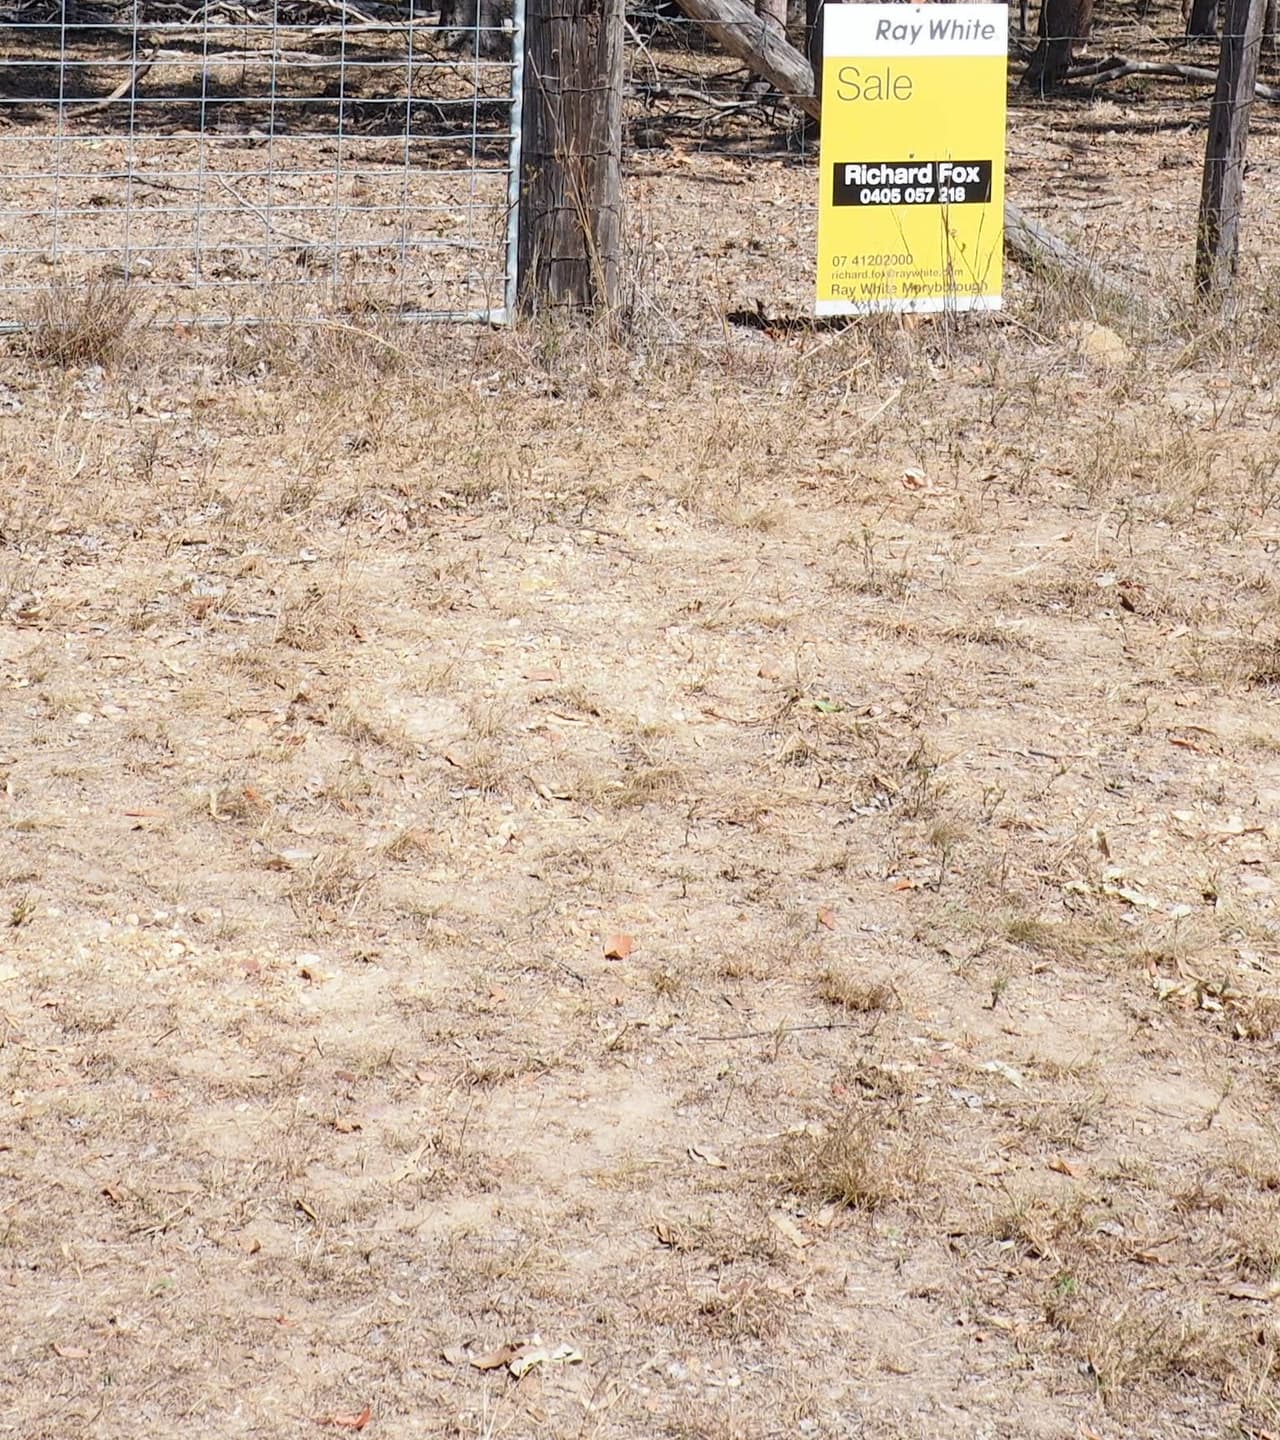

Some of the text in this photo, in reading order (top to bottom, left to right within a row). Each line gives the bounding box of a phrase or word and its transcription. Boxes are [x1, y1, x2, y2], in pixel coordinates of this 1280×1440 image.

[875, 18, 996, 45] Ray White
[836, 66, 913, 101] Sale
[844, 162, 981, 185] Richard Fox
[860, 186, 966, 204] 0405 057 218
[832, 253, 914, 267] 07 41202000
[831, 283, 856, 297] Ray
[860, 282, 898, 295] White
